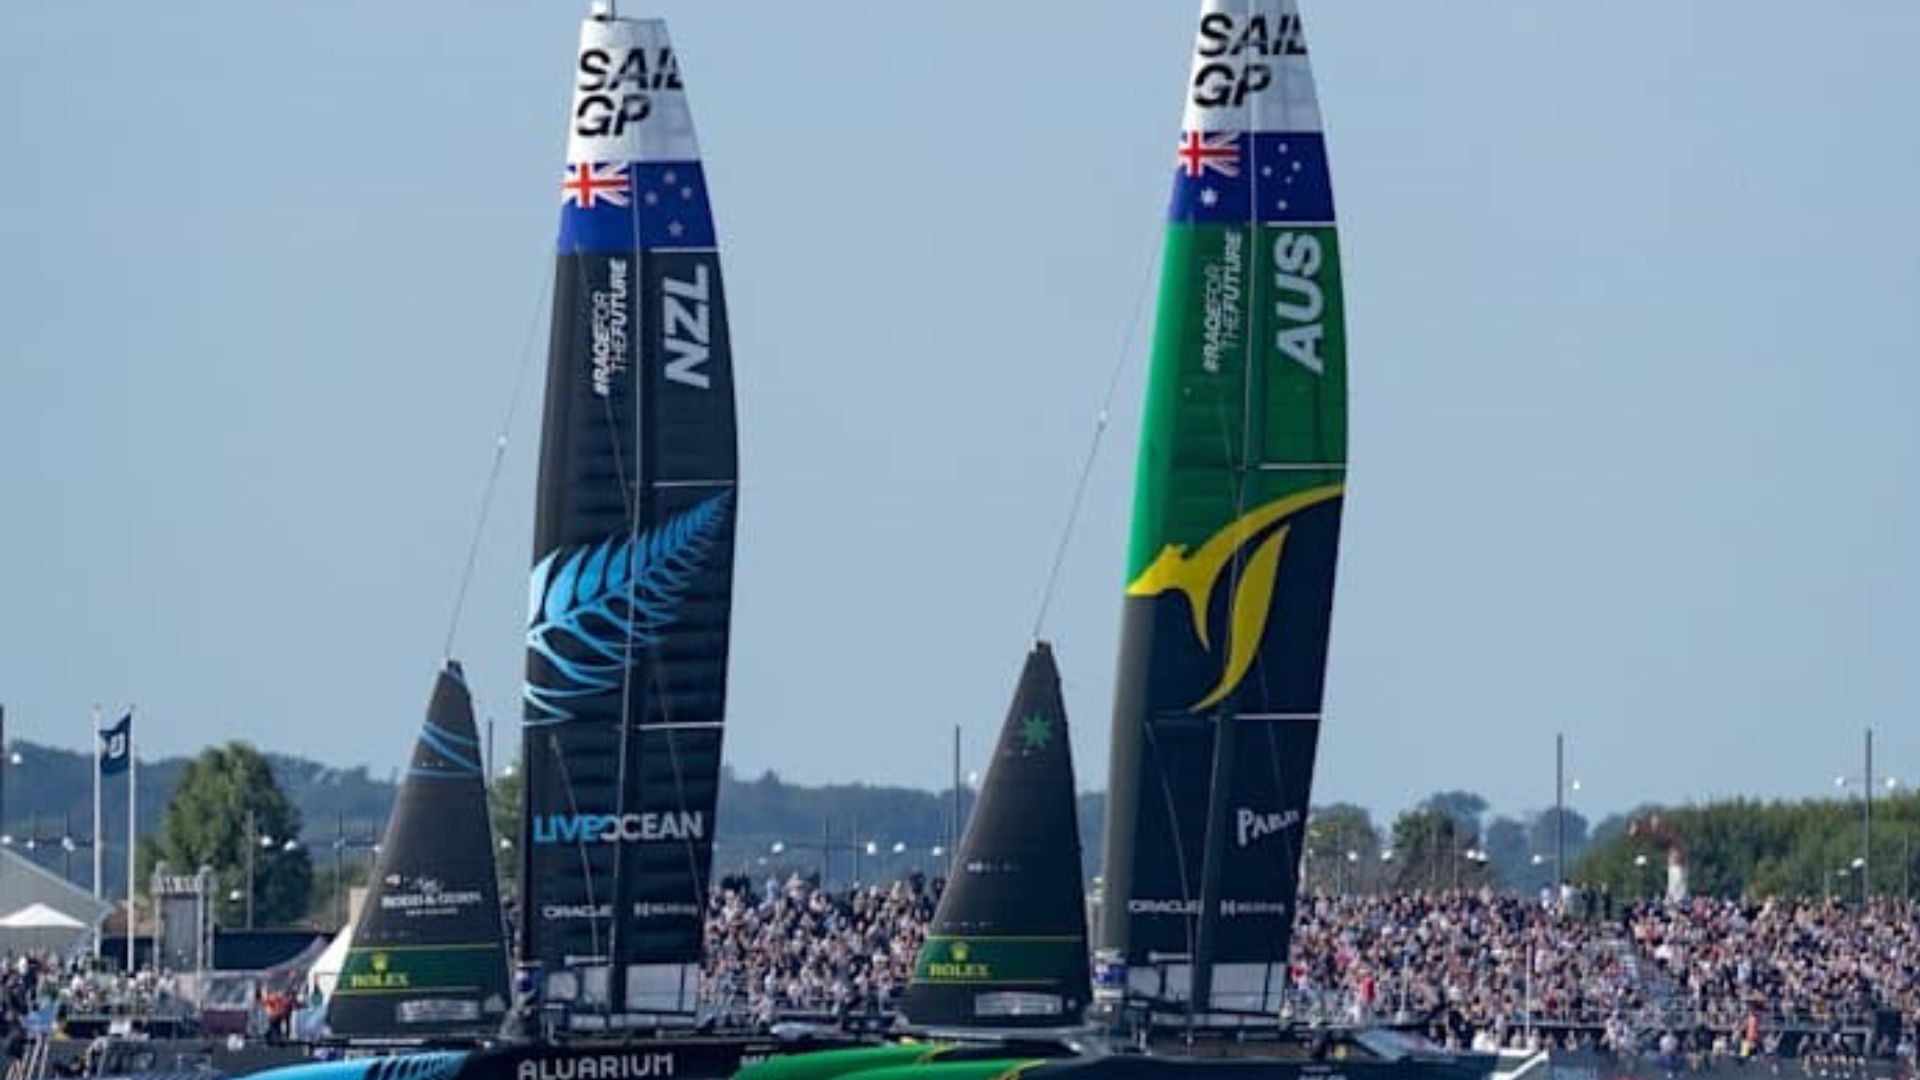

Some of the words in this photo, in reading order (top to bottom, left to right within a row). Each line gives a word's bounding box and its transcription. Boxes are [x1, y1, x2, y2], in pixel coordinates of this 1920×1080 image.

[1199, 13, 1307, 57] SAIL
[579, 48, 684, 91] SAIL
[1194, 63, 1272, 107] GP
[576, 95, 651, 136] GP
[1274, 232, 1324, 374] AUS
[663, 264, 709, 389] NZL
